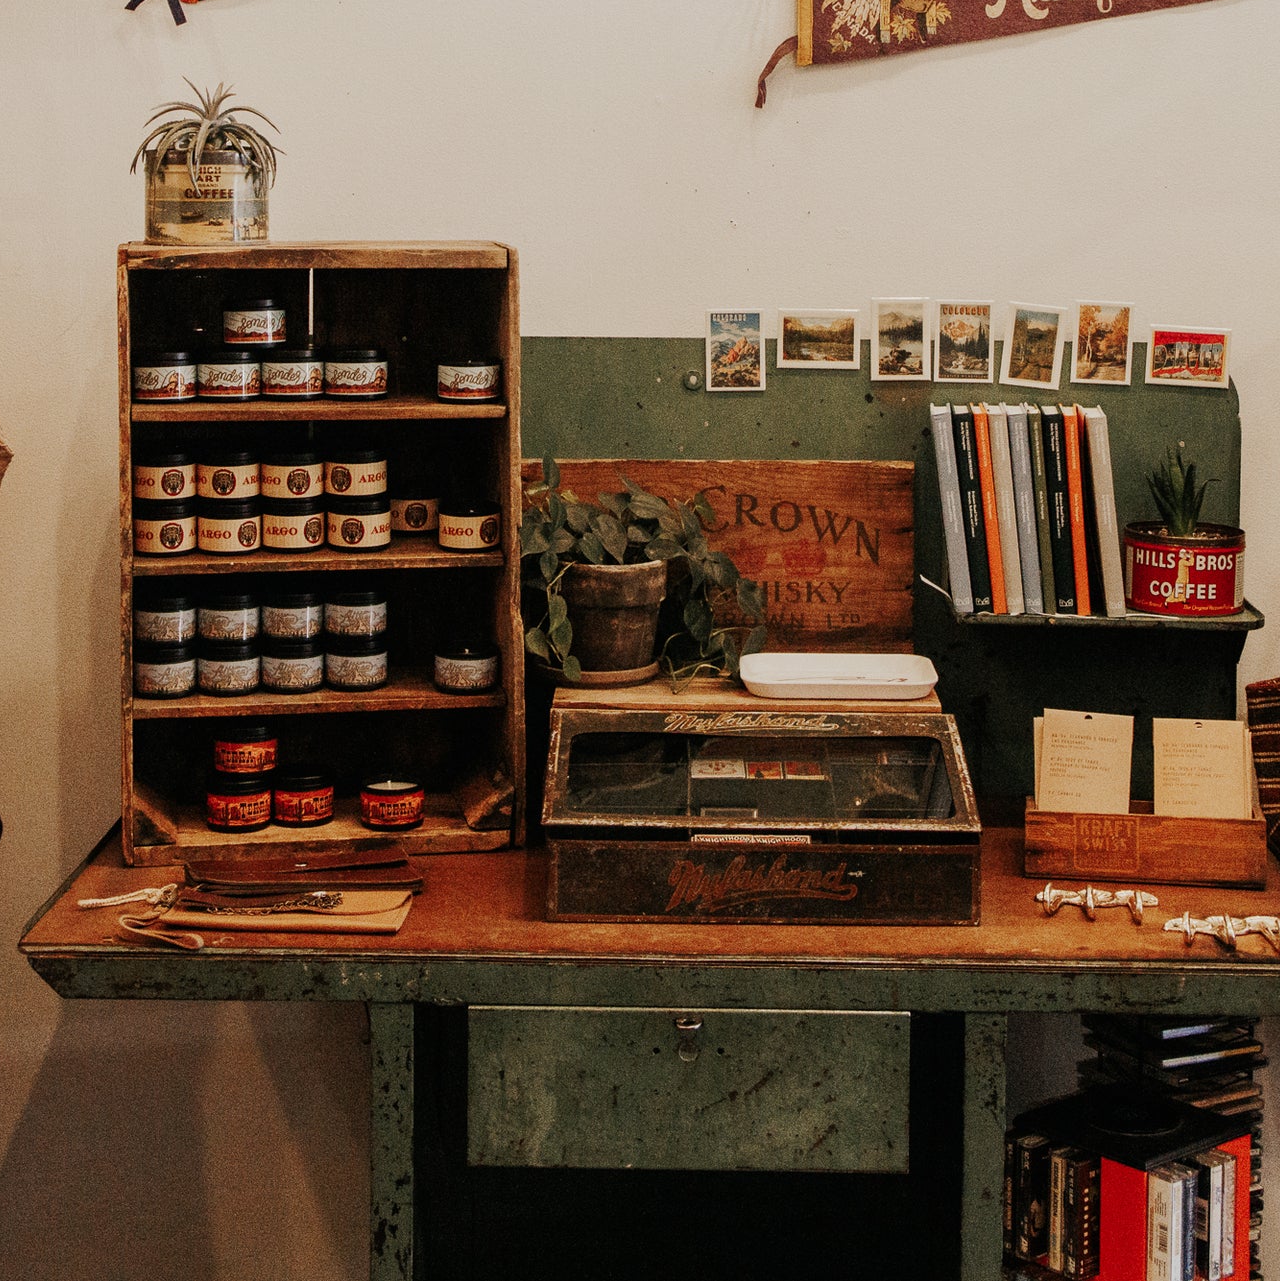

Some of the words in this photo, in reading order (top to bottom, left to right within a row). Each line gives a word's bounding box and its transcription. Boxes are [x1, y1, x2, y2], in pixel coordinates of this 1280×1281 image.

[184, 188, 235, 199] COFFEE
[265, 526, 298, 536] ARGO
[441, 525, 474, 537] ARGO
[697, 485, 881, 566] CROWN
[1136, 548, 1176, 569] HILLS
[1195, 554, 1234, 571] BROS
[1149, 580, 1217, 600] COFFEE
[1080, 819, 1134, 838] KRAFT
